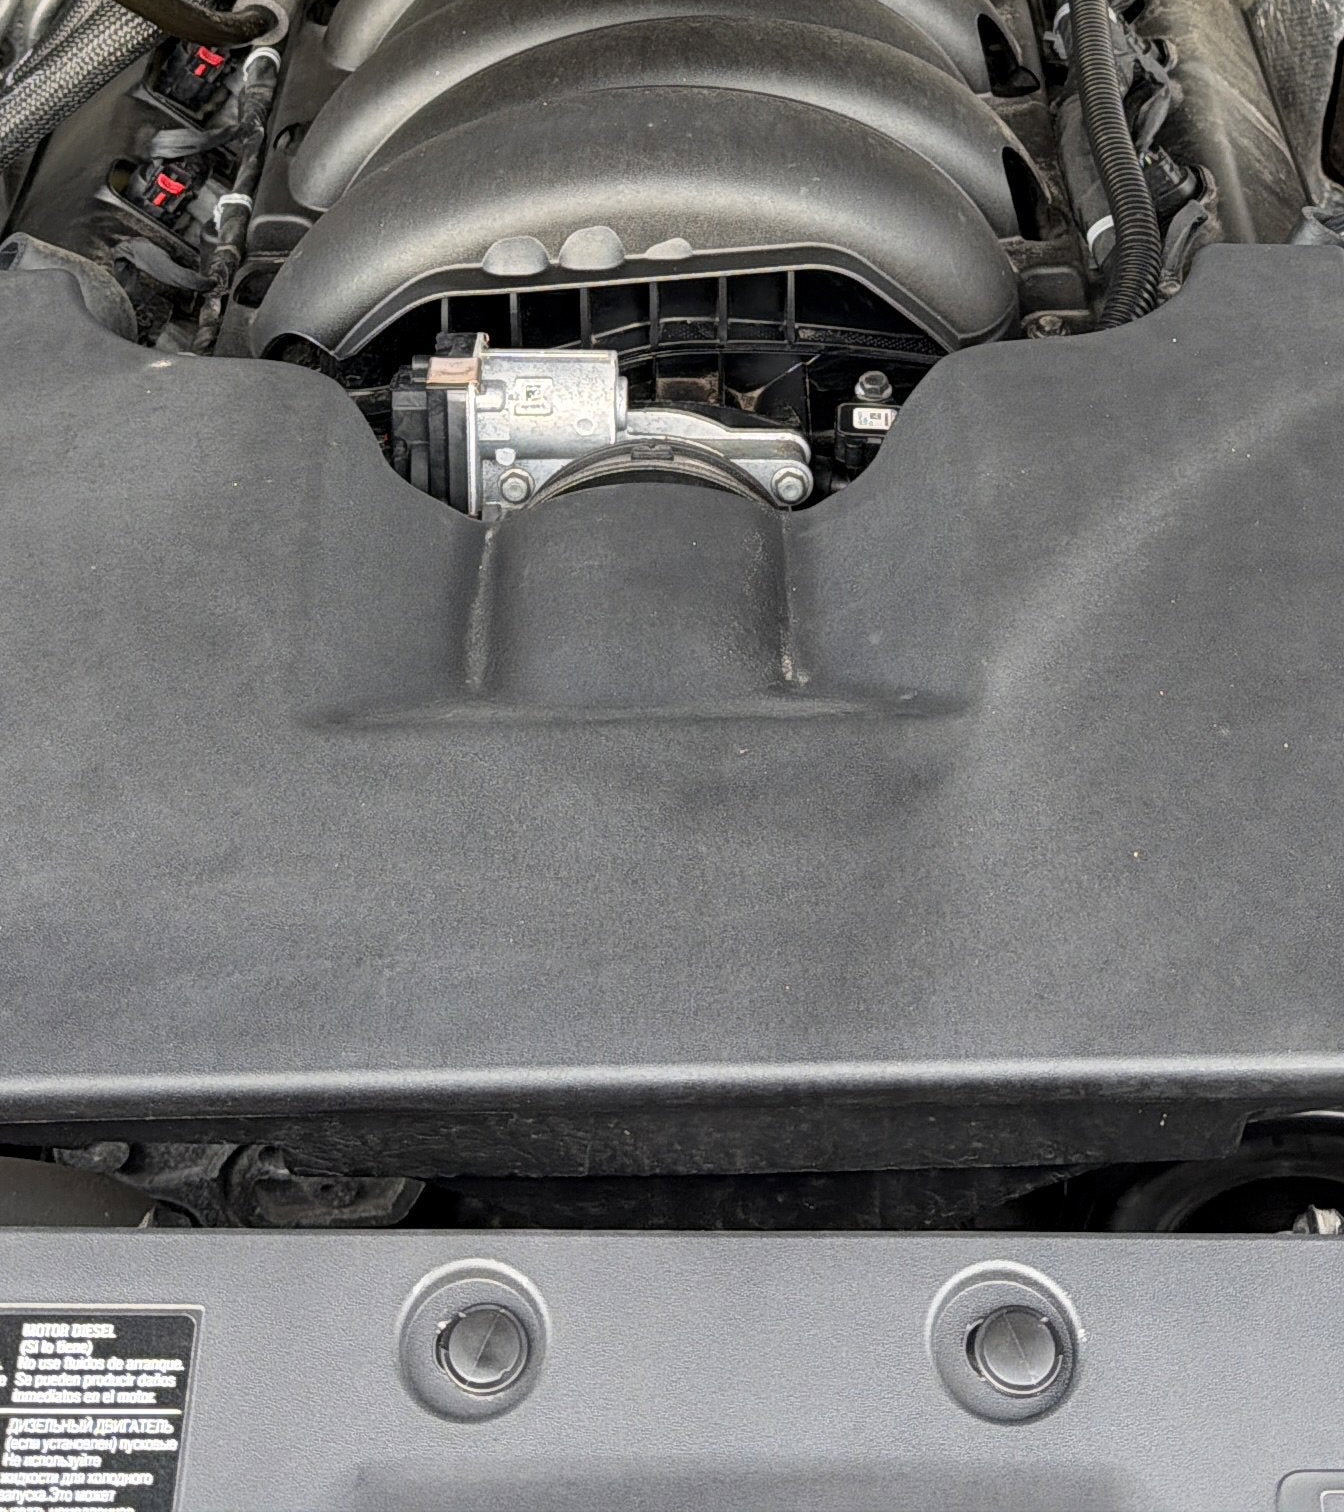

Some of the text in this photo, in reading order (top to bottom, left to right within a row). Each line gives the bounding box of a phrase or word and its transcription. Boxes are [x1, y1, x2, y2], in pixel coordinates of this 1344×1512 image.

[22, 1323, 118, 1338] MOTOR DIESEL
[17, 1355, 37, 1370] No
[106, 1356, 124, 1370] de
[14, 1372, 32, 1387] Se
[34, 1372, 81, 1389] pueden
[82, 1372, 136, 1389] producir
[83, 1391, 100, 1403] en
[102, 1389, 115, 1403] el
[7, 1416, 174, 1436] ДИЗЕЛЬНЫЙ ДВИГАТЕЛЬ
